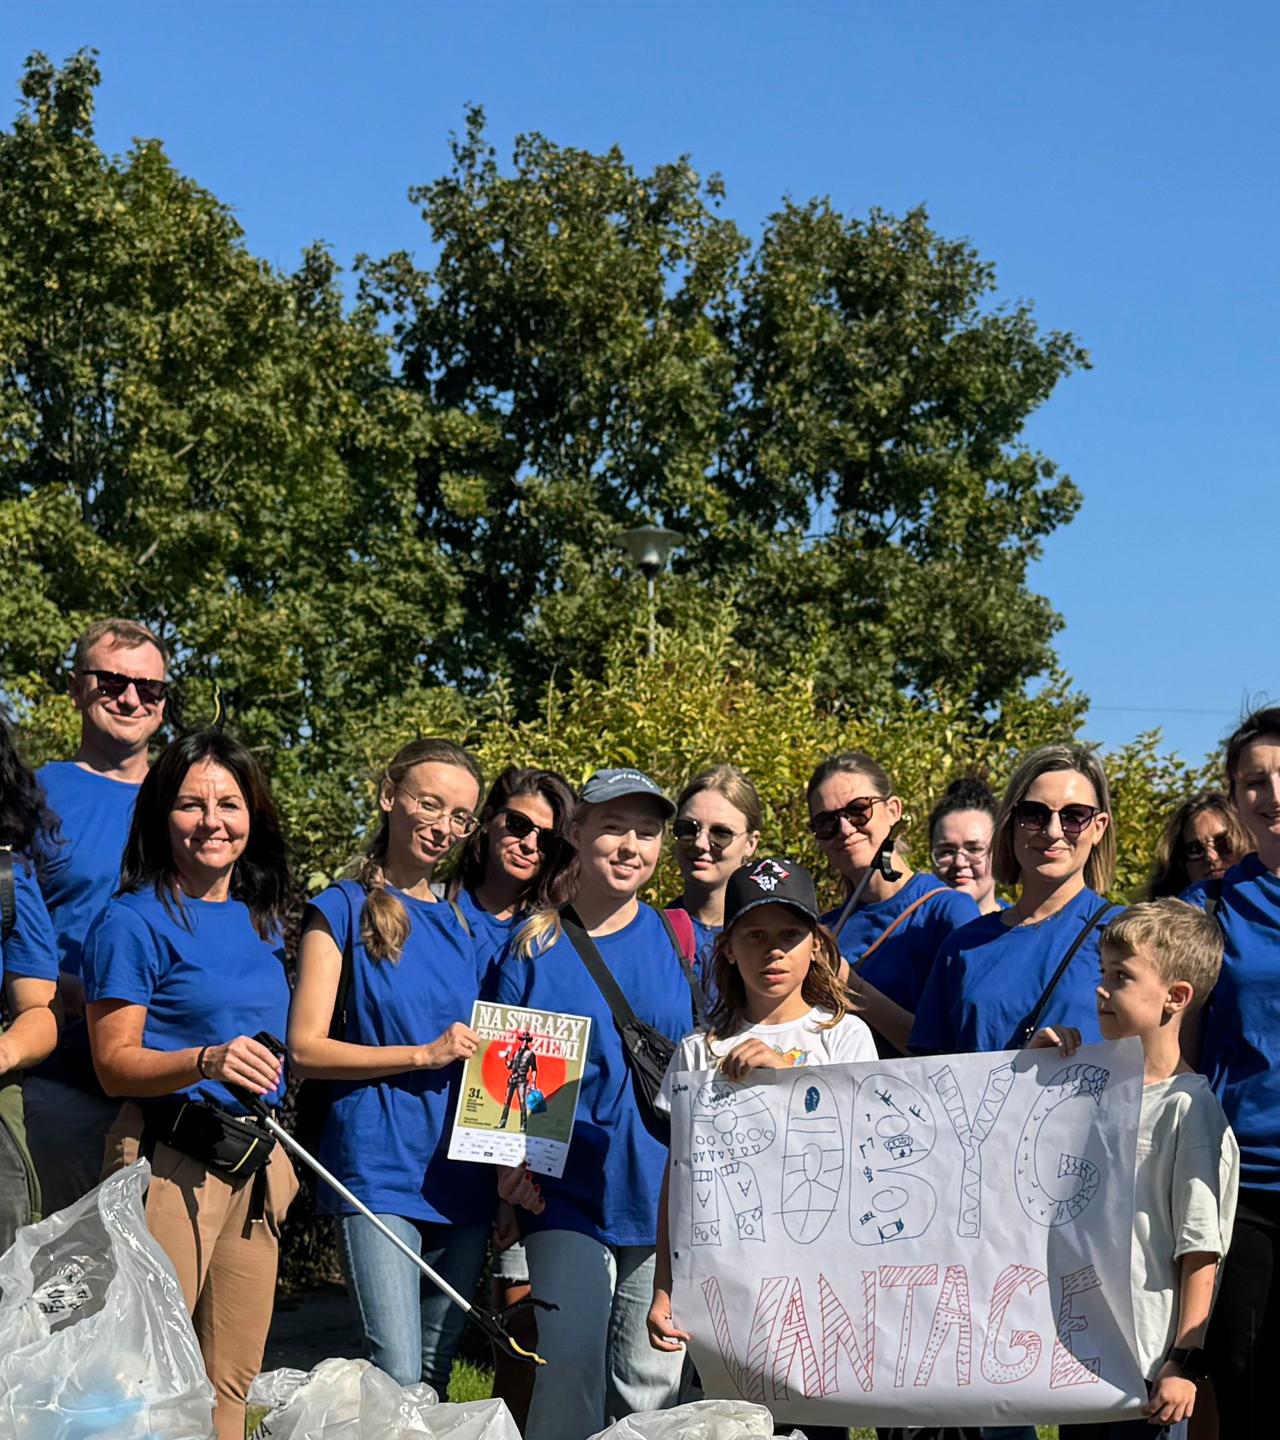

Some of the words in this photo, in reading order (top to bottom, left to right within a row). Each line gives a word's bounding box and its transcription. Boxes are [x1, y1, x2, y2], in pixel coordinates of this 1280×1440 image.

[478, 1005, 504, 1030] NA
[506, 1010, 585, 1042] STRAŻY
[532, 1035, 580, 1060] ZIEMI
[468, 1087, 483, 1099] 31.
[691, 1063, 1110, 1246] ROBYG
[700, 1264, 1103, 1402] VANTAGE
